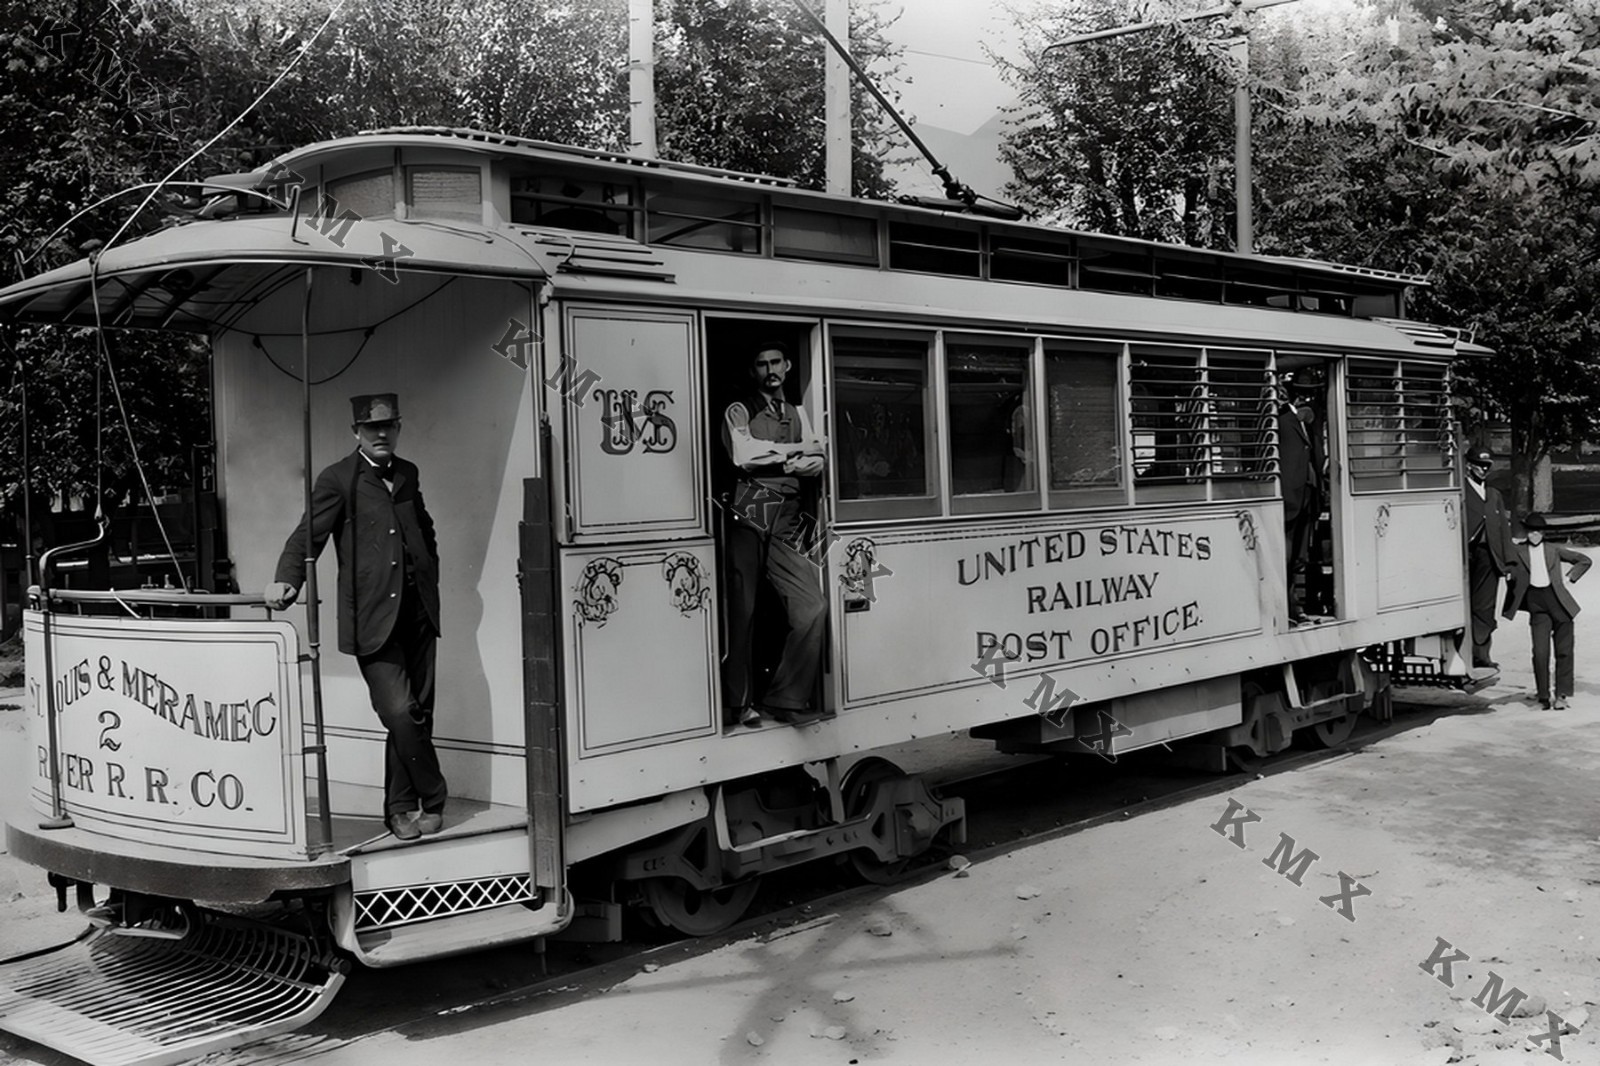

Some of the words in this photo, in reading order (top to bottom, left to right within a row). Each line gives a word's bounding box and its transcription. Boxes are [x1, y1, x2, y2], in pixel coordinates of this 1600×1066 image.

[957, 530, 1086, 586] UNITED
[1099, 525, 1212, 561] STATES
[1026, 572, 1160, 614] RAILWAY
[976, 630, 1073, 662] POST
[55, 658, 92, 713] OUIS
[97, 655, 116, 692] &
[121, 660, 277, 744] MERAMEC
[98, 710, 122, 752] 2
[38, 745, 94, 793] RER
[190, 769, 254, 811] CO.
